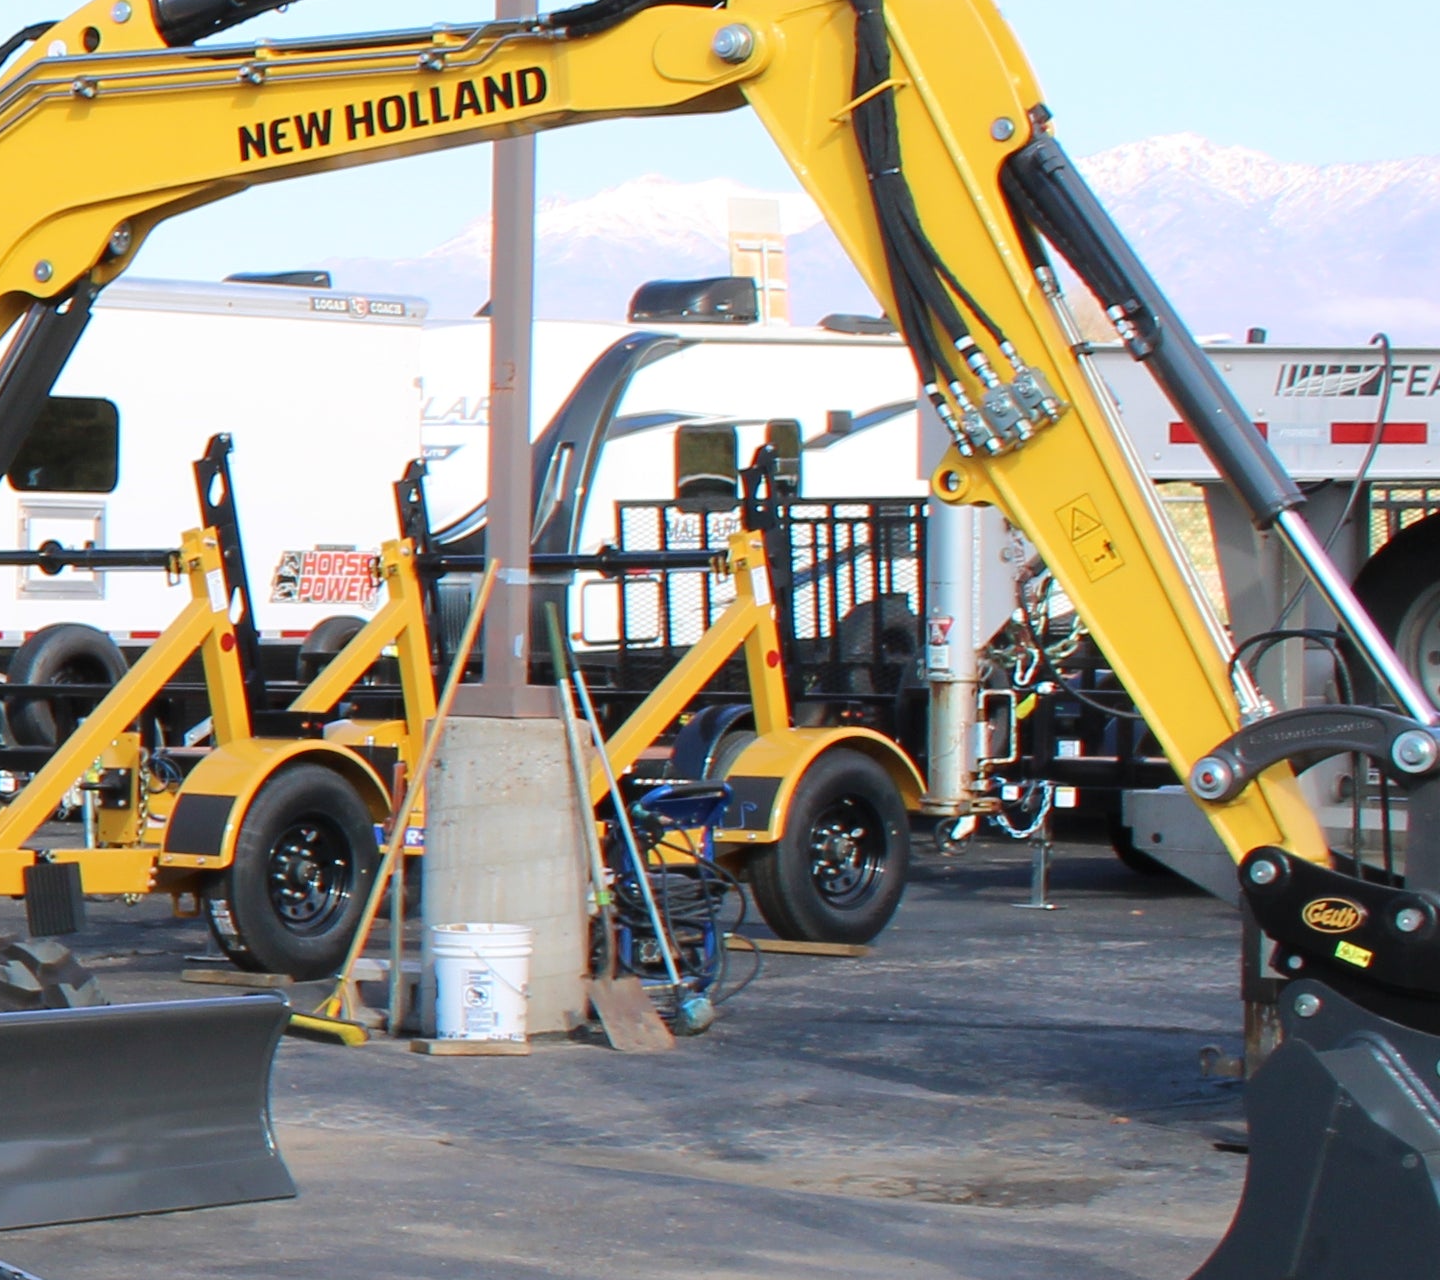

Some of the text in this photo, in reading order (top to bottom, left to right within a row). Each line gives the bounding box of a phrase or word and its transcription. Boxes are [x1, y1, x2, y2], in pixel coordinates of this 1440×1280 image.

[237, 66, 547, 162] NEW HOLLAND
[302, 552, 374, 577] HORSE
[298, 577, 379, 603] POWER
